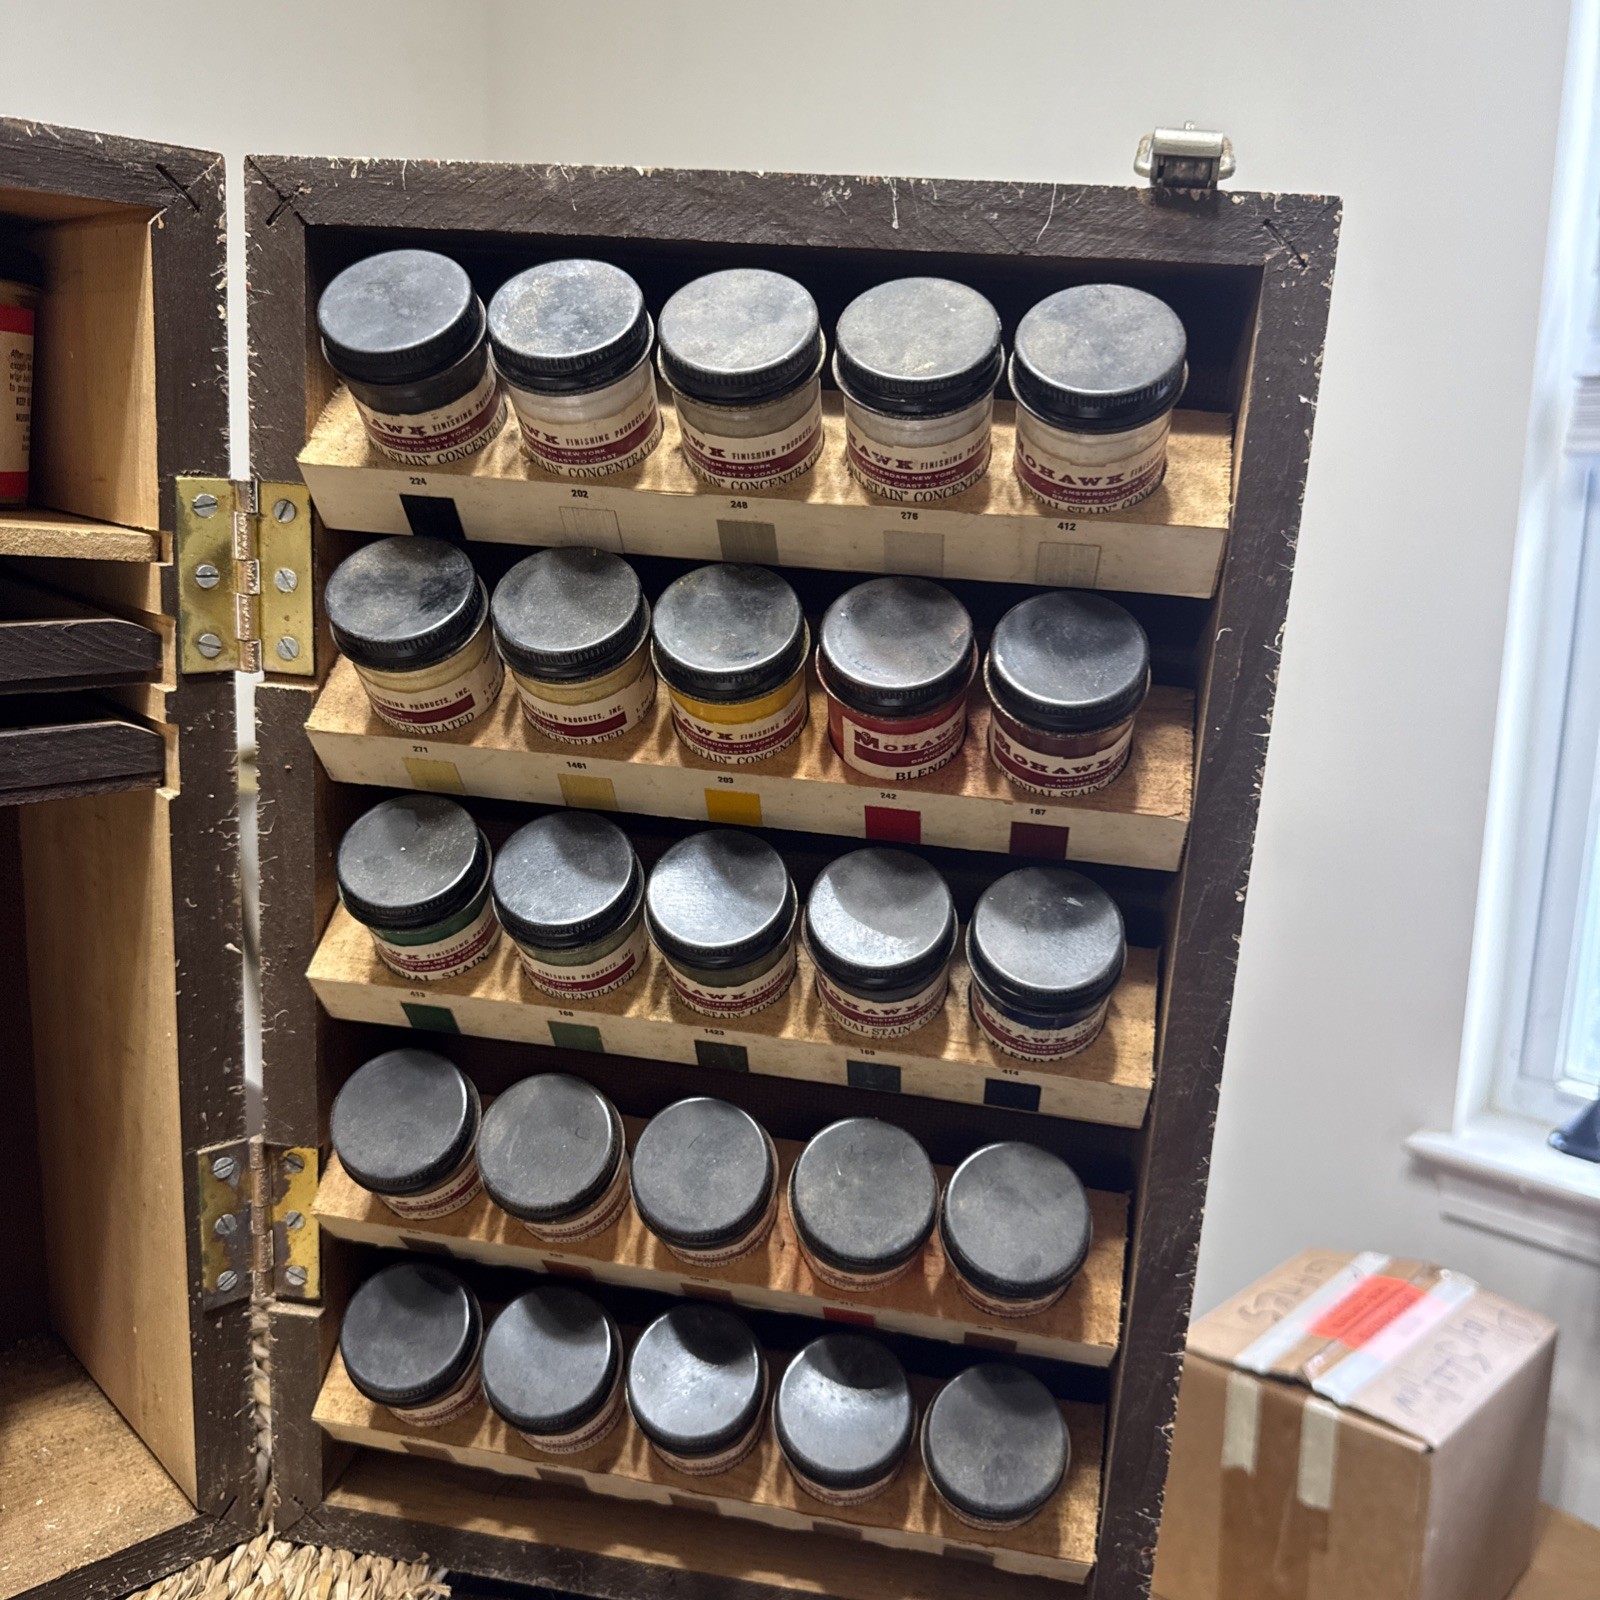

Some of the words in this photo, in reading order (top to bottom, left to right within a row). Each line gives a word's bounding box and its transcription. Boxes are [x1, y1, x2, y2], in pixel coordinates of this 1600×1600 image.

[566, 434, 610, 446] FINISHING
[732, 449, 776, 460] FINISHING
[920, 453, 962, 470] FINISHING
[410, 477, 427, 485] 224
[571, 489, 588, 498] 202
[731, 501, 748, 509] 248
[1058, 522, 1076, 531] 412
[881, 792, 896, 800] 242
